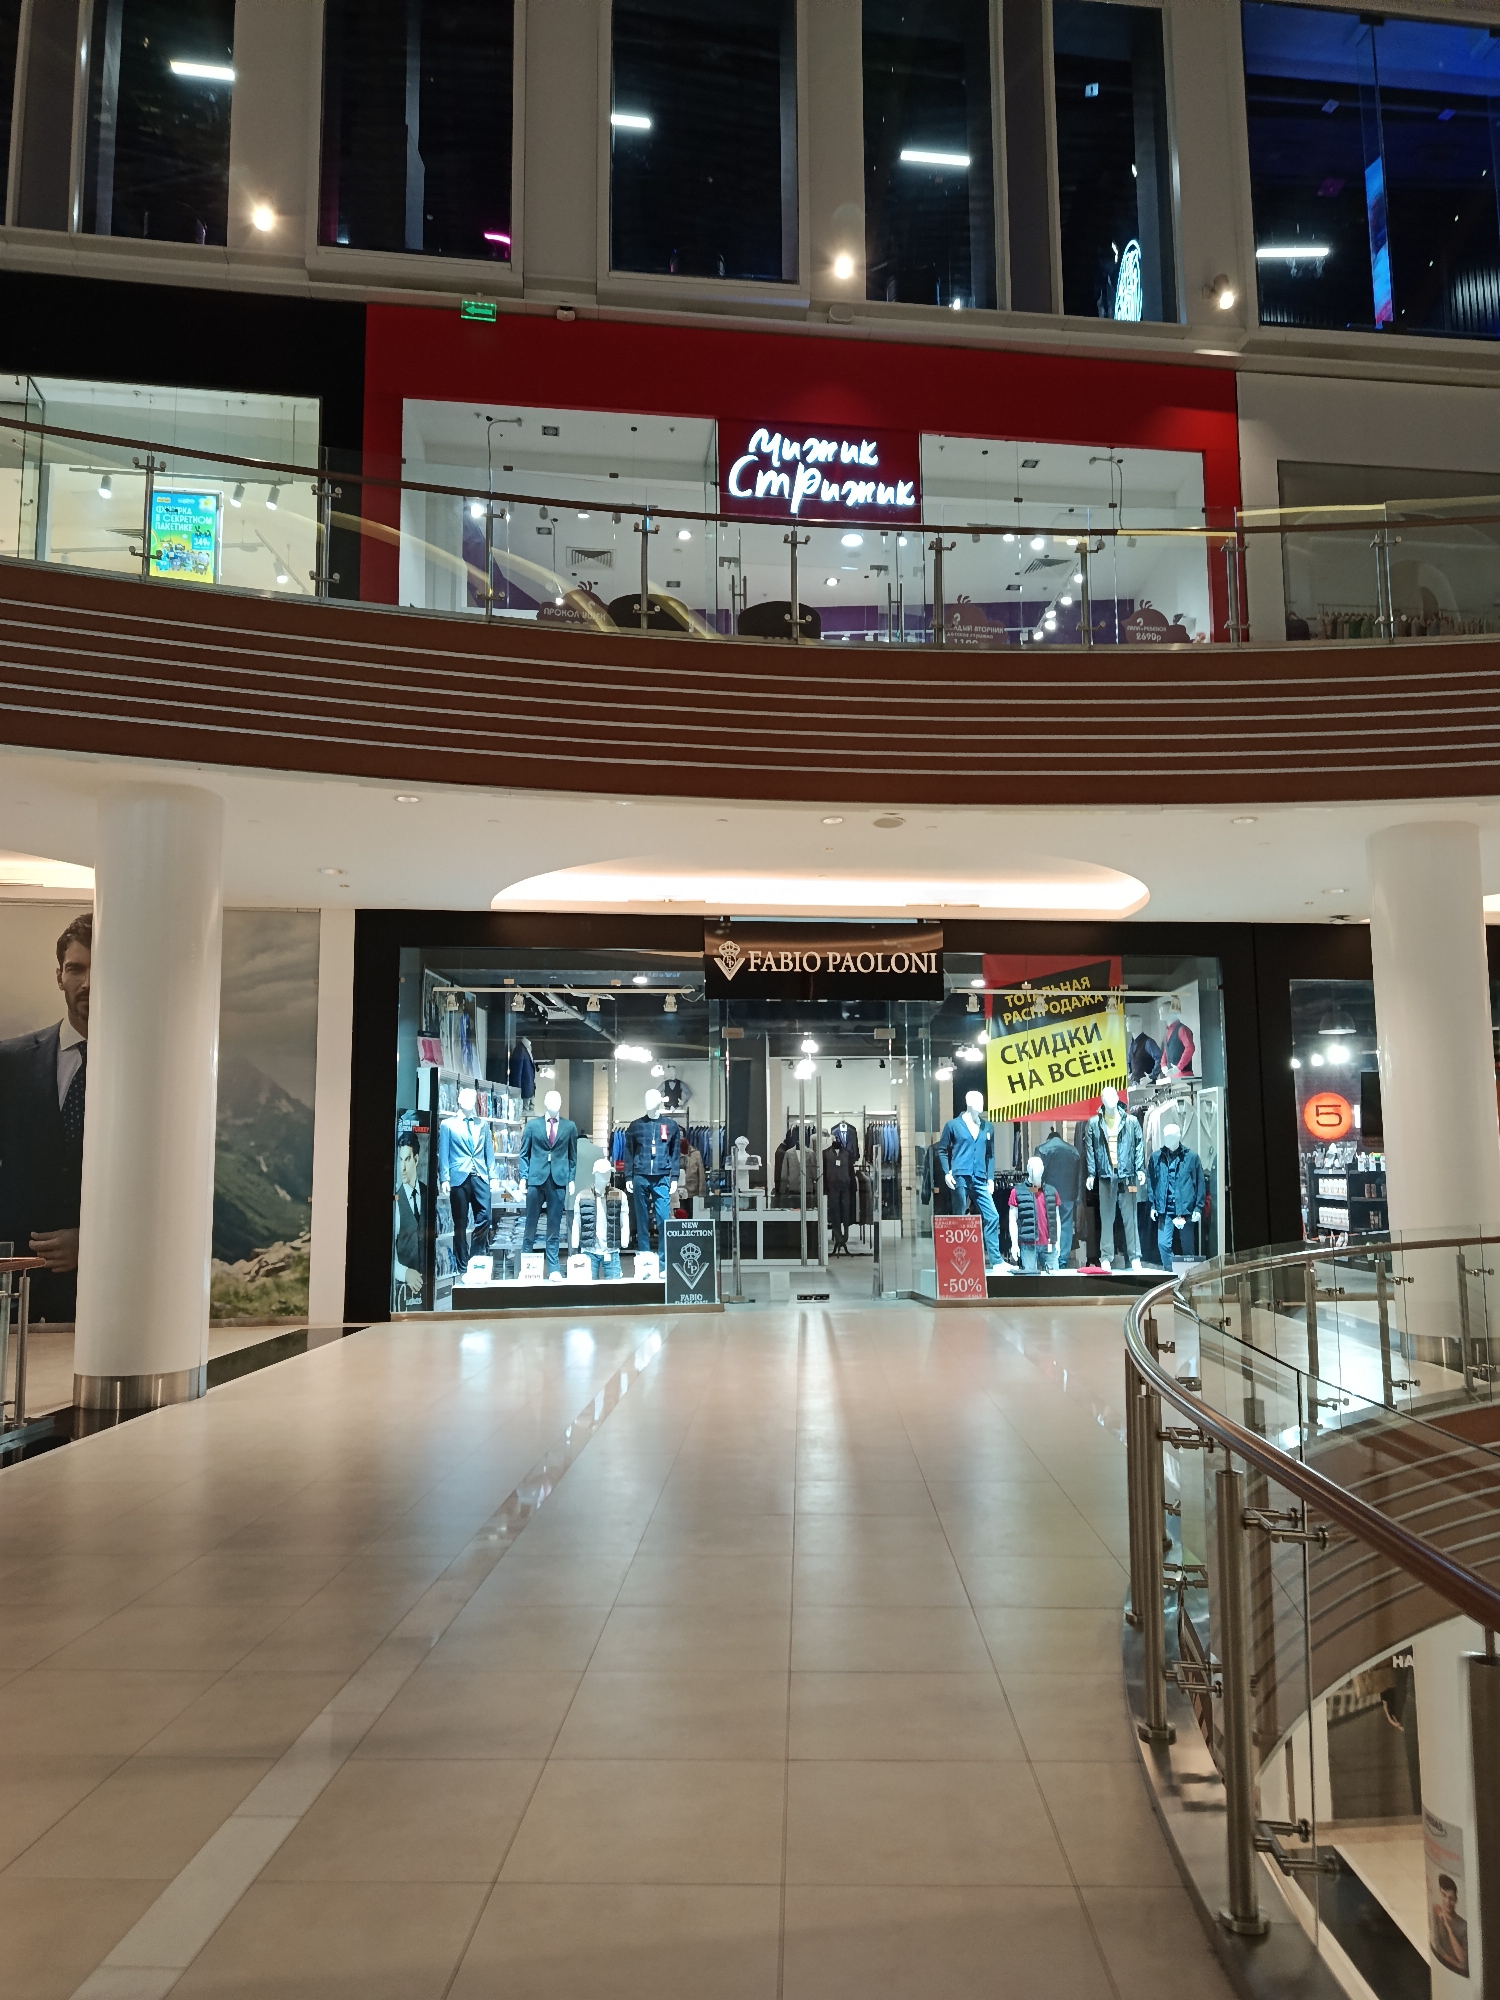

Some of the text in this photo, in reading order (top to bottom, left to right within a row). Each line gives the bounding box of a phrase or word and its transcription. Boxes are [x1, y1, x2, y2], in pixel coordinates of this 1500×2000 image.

[728, 454, 916, 515] Стрижик
[162, 513, 213, 525] СЕКРЕТНОМ
[155, 521, 193, 532] ПАКЕТИКЕ
[543, 607, 580, 619] ПРОКОЛ
[974, 625, 1004, 634] ВТОРНИК
[748, 950, 822, 973] FABIO
[826, 951, 938, 974] PAOLONI
[1000, 1022, 1103, 1065] СКИДКИ
[1007, 1048, 1116, 1094] НА ВСЁ!!!
[681, 1221, 699, 1229] NEW
[666, 1229, 713, 1238] COLLECTION
[939, 1229, 979, 1244] -30%
[943, 1277, 982, 1293] -50%
[679, 1293, 703, 1301] FABIO
